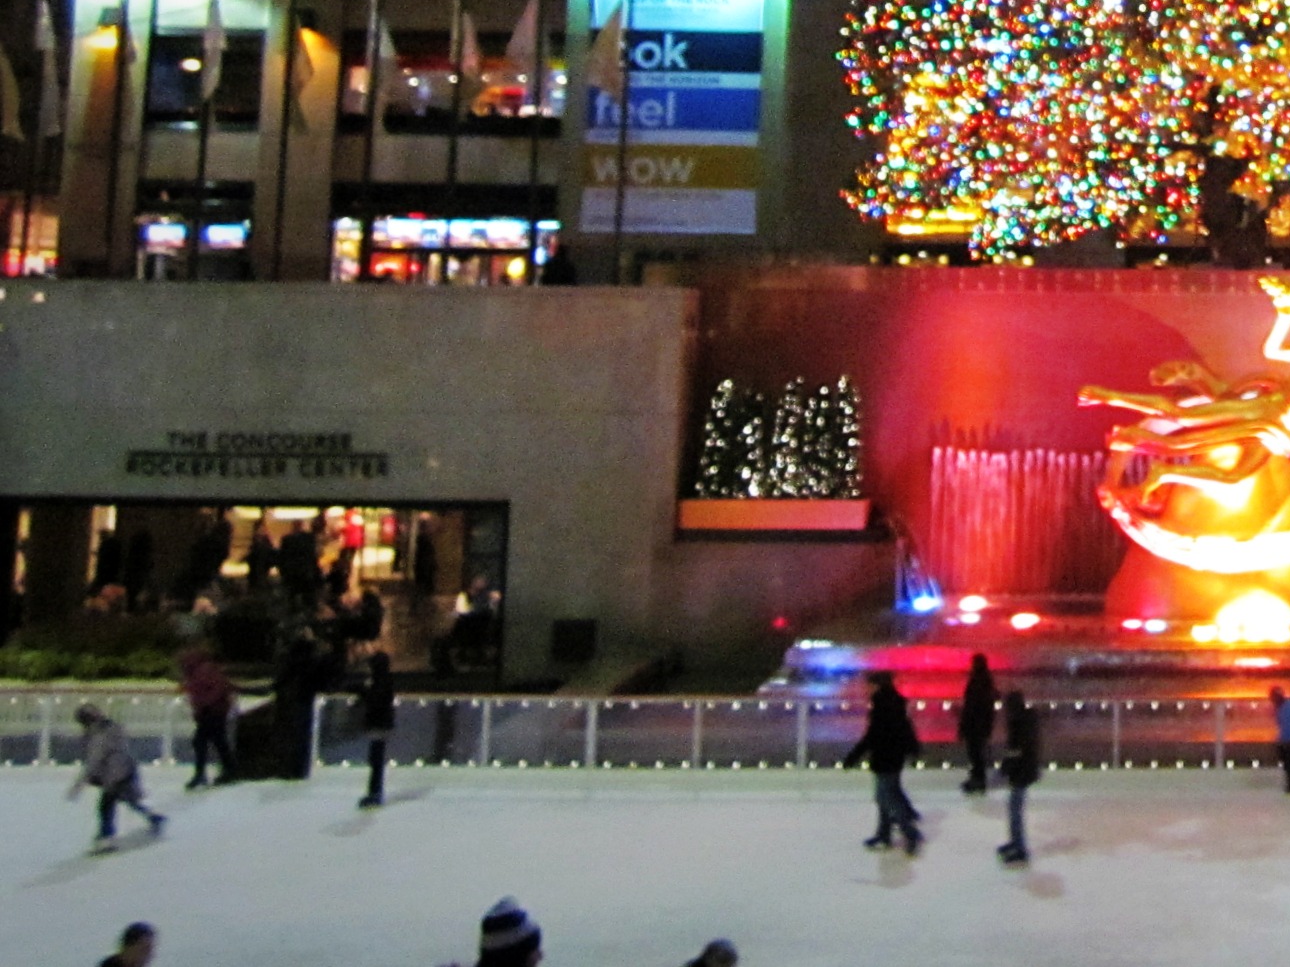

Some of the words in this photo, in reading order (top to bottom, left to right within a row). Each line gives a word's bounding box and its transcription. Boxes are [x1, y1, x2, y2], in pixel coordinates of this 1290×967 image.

[630, 33, 688, 69] ok
[169, 431, 207, 449] THE
[218, 431, 352, 451] CONCOURSE
